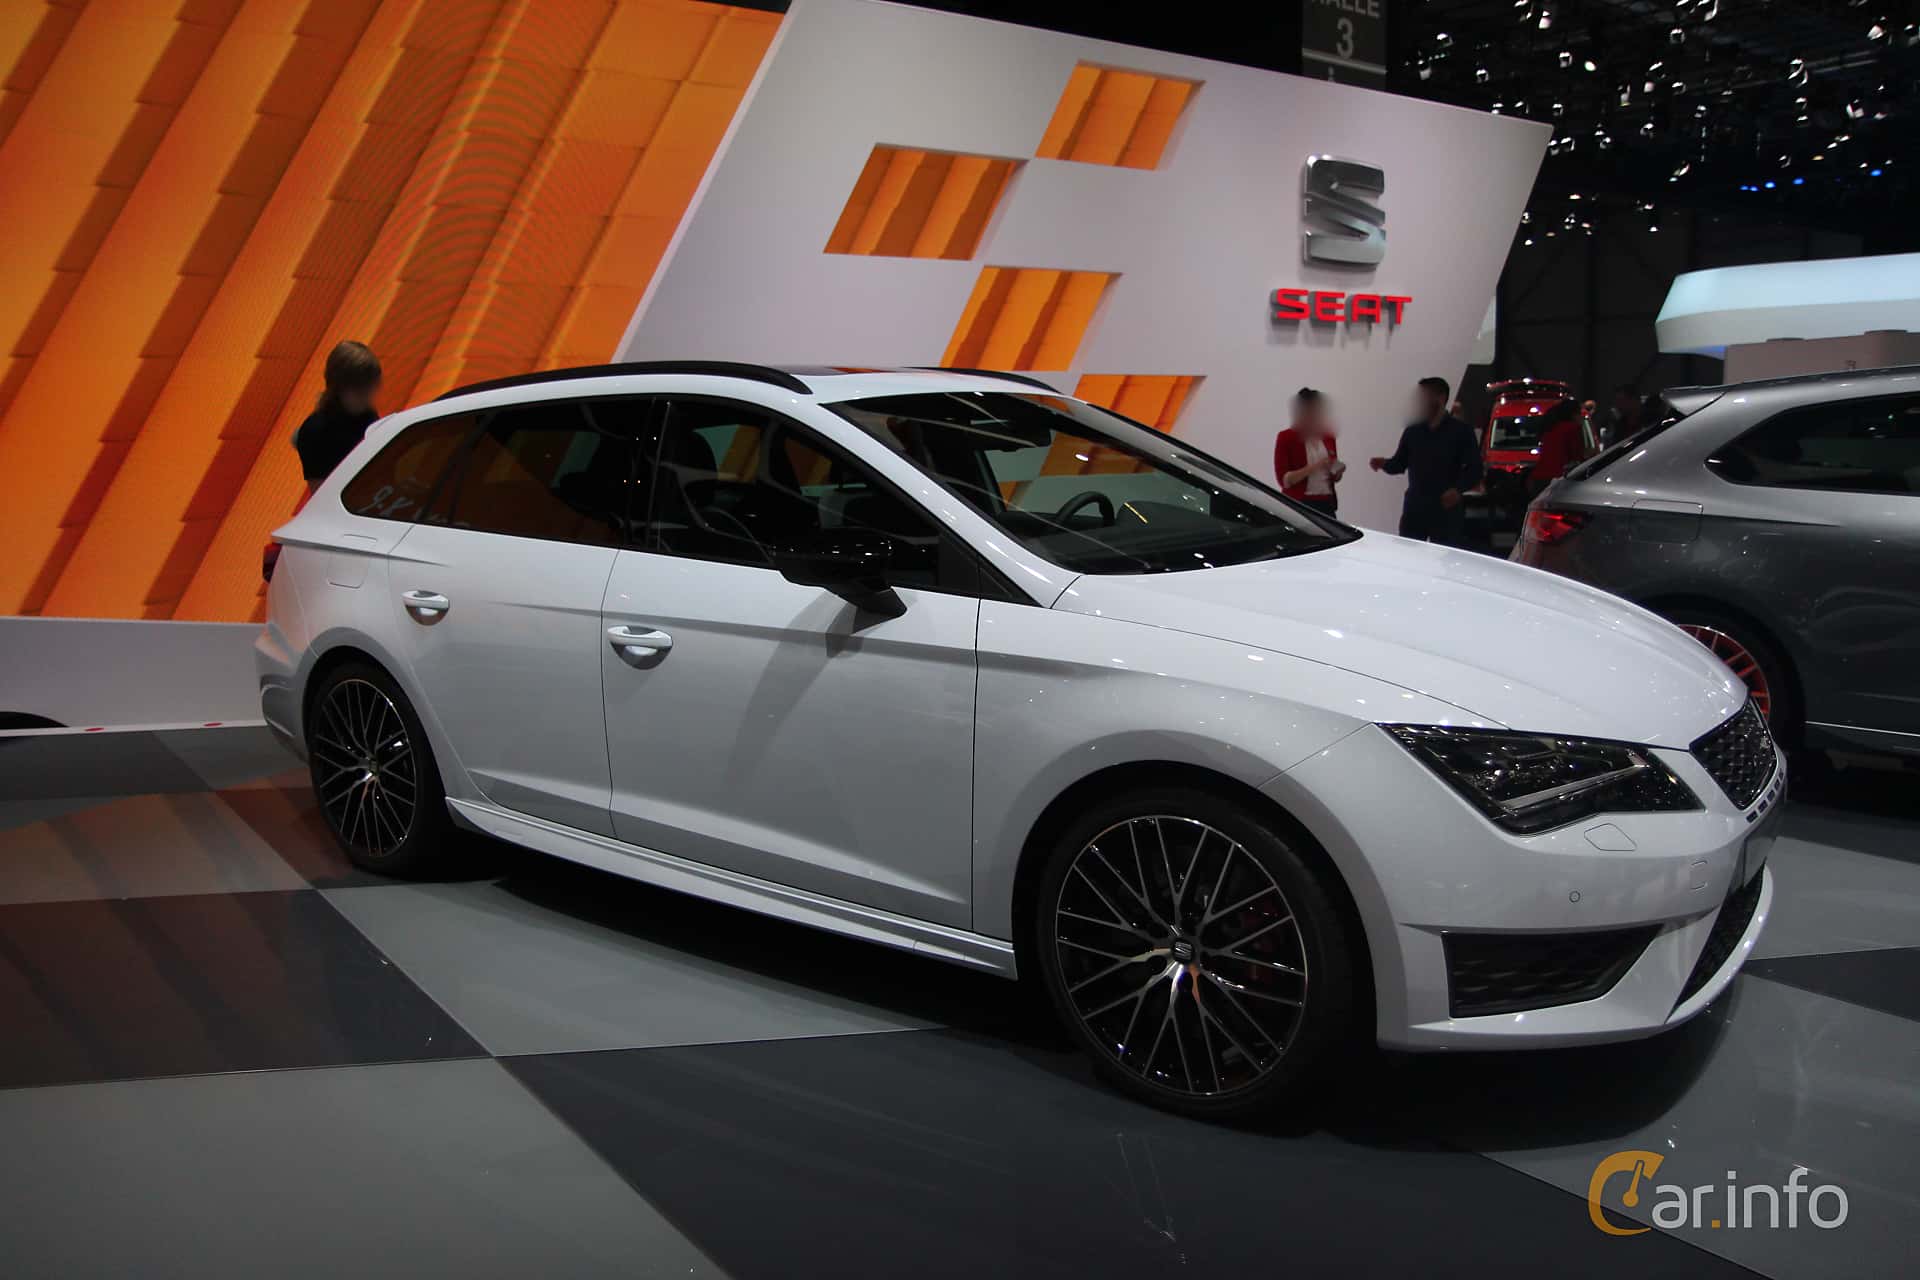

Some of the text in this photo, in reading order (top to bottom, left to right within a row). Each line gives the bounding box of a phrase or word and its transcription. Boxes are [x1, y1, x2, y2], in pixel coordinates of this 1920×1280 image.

[1311, 0, 1380, 18] LLE
[1336, 17, 1354, 59] 3
[1274, 288, 1413, 325] SEAT
